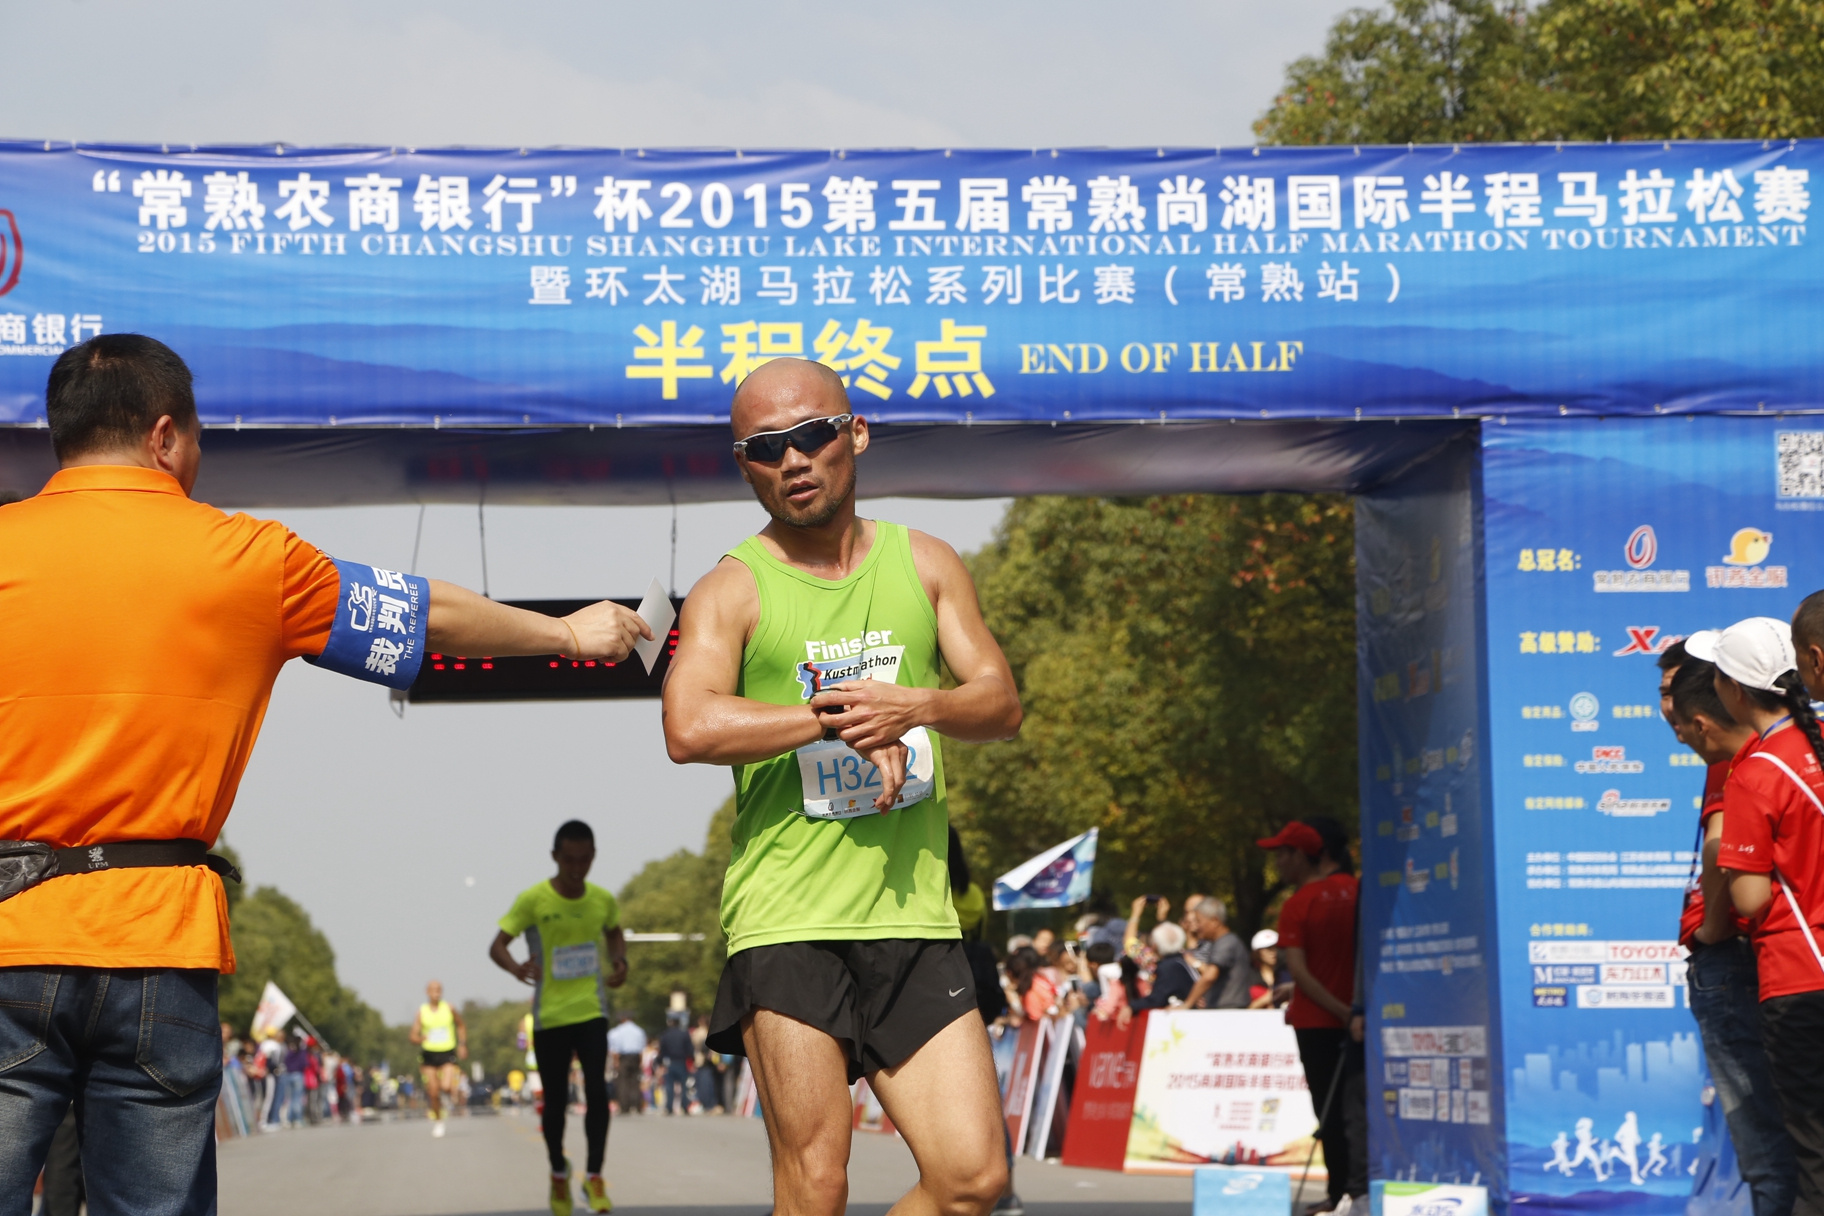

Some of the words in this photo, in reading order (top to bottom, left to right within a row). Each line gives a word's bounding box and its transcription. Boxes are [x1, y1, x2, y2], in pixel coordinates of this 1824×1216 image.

[137, 231, 217, 255] 2015
[230, 232, 348, 256] FIFTH
[360, 234, 574, 257] CHANGSHU
[586, 235, 771, 257] SHANGHU
[784, 235, 881, 257] LAKE
[893, 233, 1201, 257] INTERNATIONAL
[1213, 232, 1309, 255] HALF
[1321, 229, 1530, 253] MARATHON
[1542, 224, 1807, 250] TOURNAMENT
[625, 318, 996, 400] 半程终点
[1018, 342, 1109, 374] END
[1120, 342, 1178, 374] OF
[1188, 341, 1304, 373] HALF
[403, 638, 415, 660] THE
[409, 582, 419, 634] REFEREE
[823, 655, 897, 681] Kustmathon
[816, 745, 918, 796] H322
[88, 861, 109, 869] UPM
[1610, 945, 1682, 959] TOYOTA
